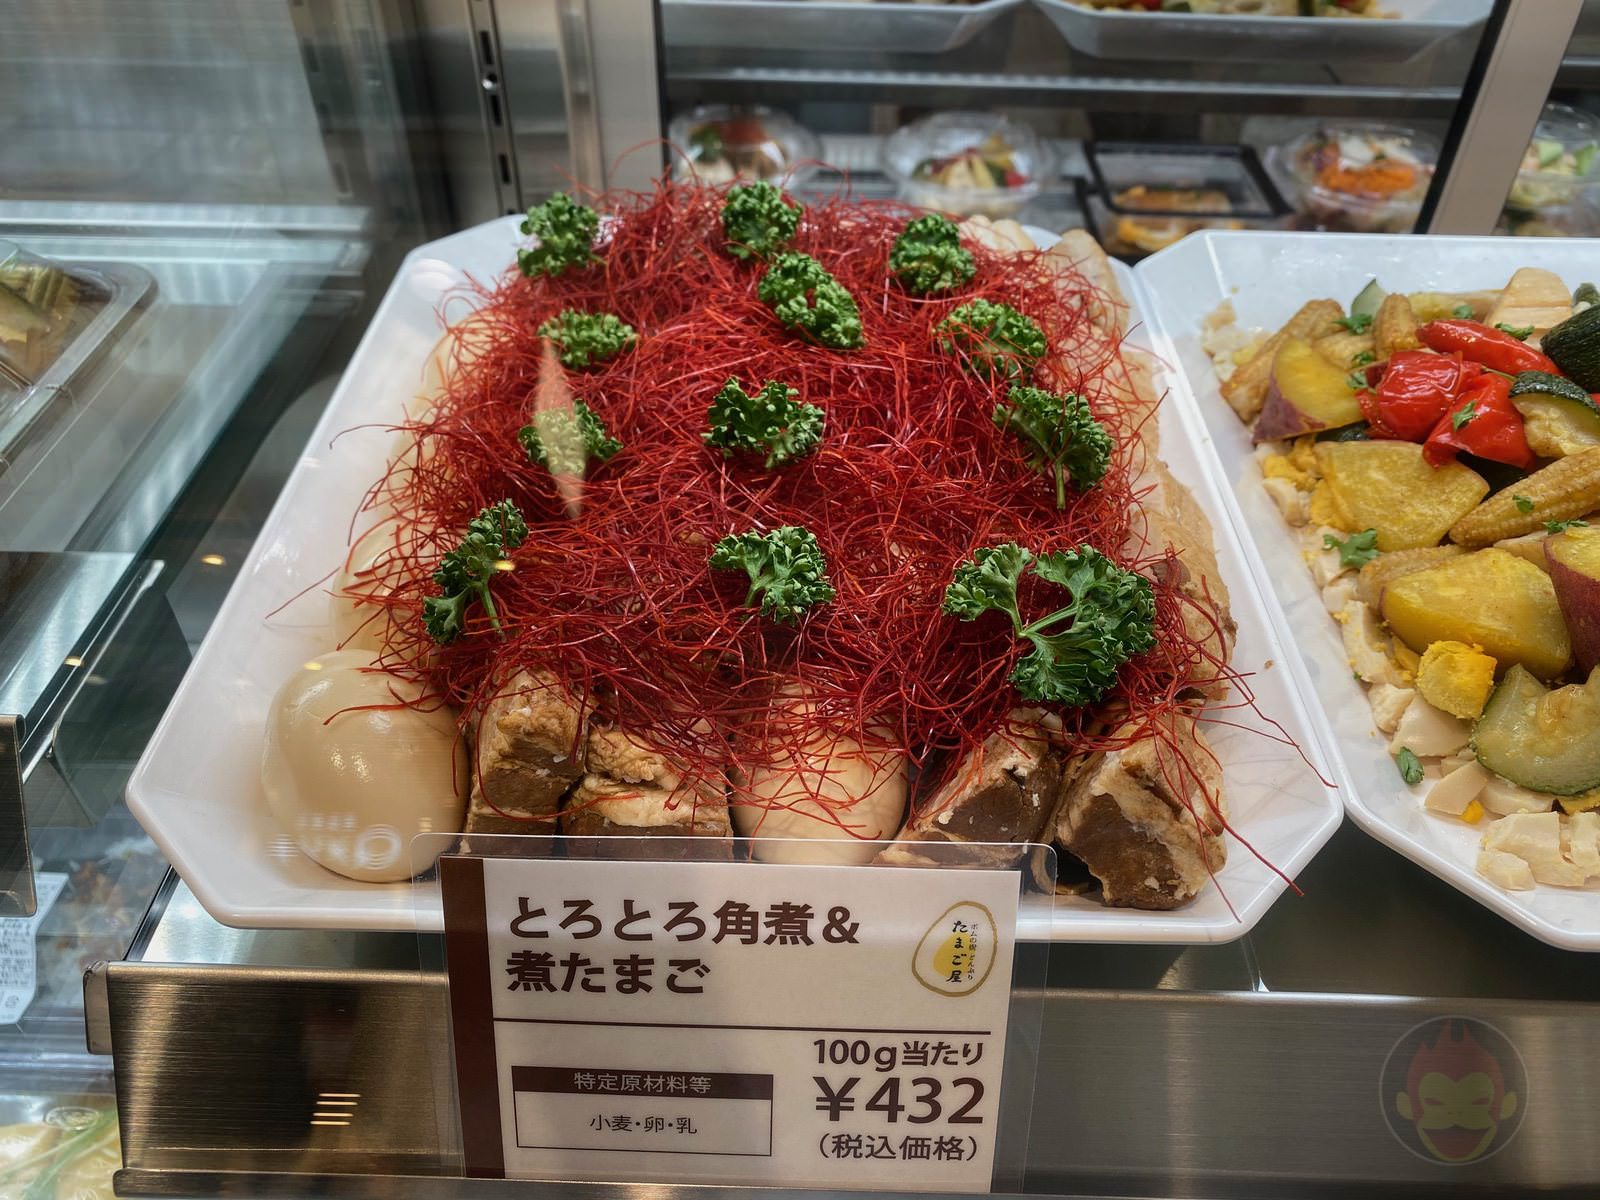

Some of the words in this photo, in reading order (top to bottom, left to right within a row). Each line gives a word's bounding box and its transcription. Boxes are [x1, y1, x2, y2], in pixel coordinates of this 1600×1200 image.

[509, 897, 860, 946] とろとろ角煮&
[506, 951, 711, 994] 煮たまご
[946, 920, 968, 982] たまご屋
[814, 1039, 984, 1072] 100g当たり
[574, 1072, 712, 1094] 特定原材料等
[813, 1076, 985, 1124] ¥432
[590, 1114, 698, 1134] 小麦・卵・乳
